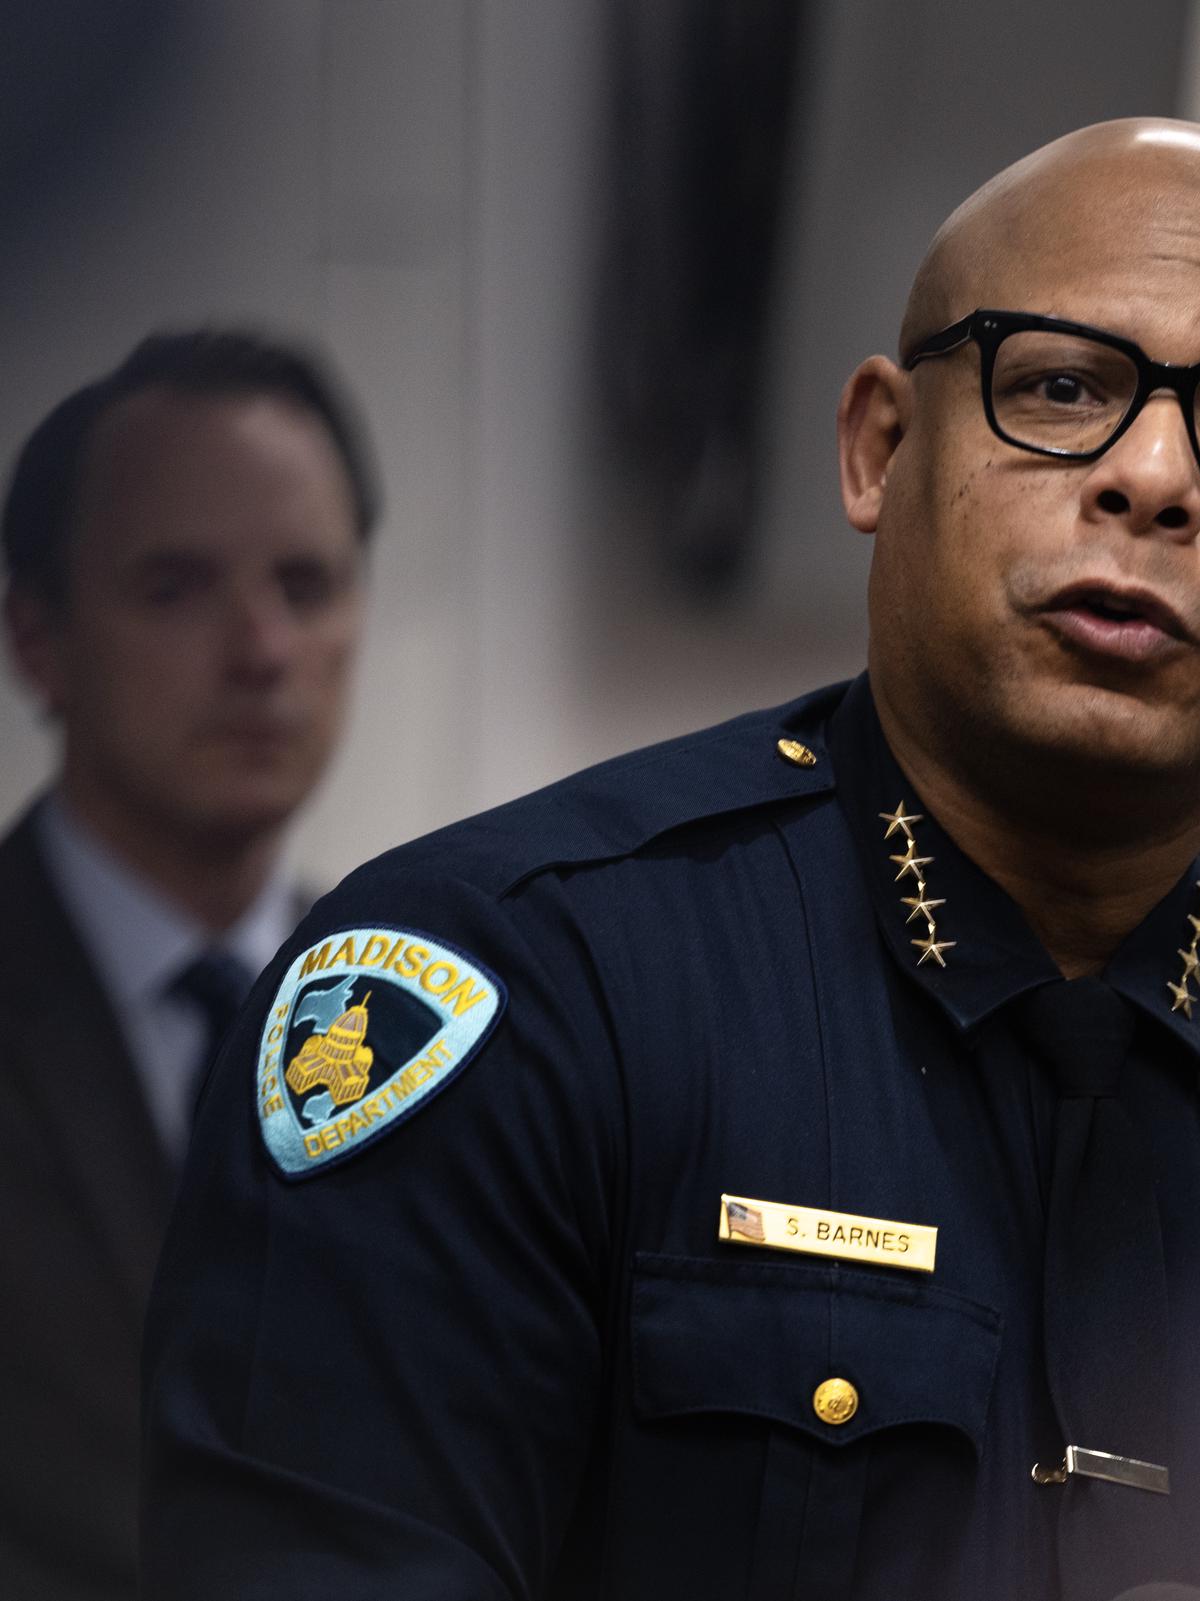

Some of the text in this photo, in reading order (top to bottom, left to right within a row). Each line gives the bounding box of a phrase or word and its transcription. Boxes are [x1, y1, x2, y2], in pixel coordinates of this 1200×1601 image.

[298, 934, 488, 1018] MADISON
[263, 1003, 289, 1119] POLICE
[303, 1039, 453, 1158] DEPARTMENT
[785, 1217, 910, 1253] S. BARNES
